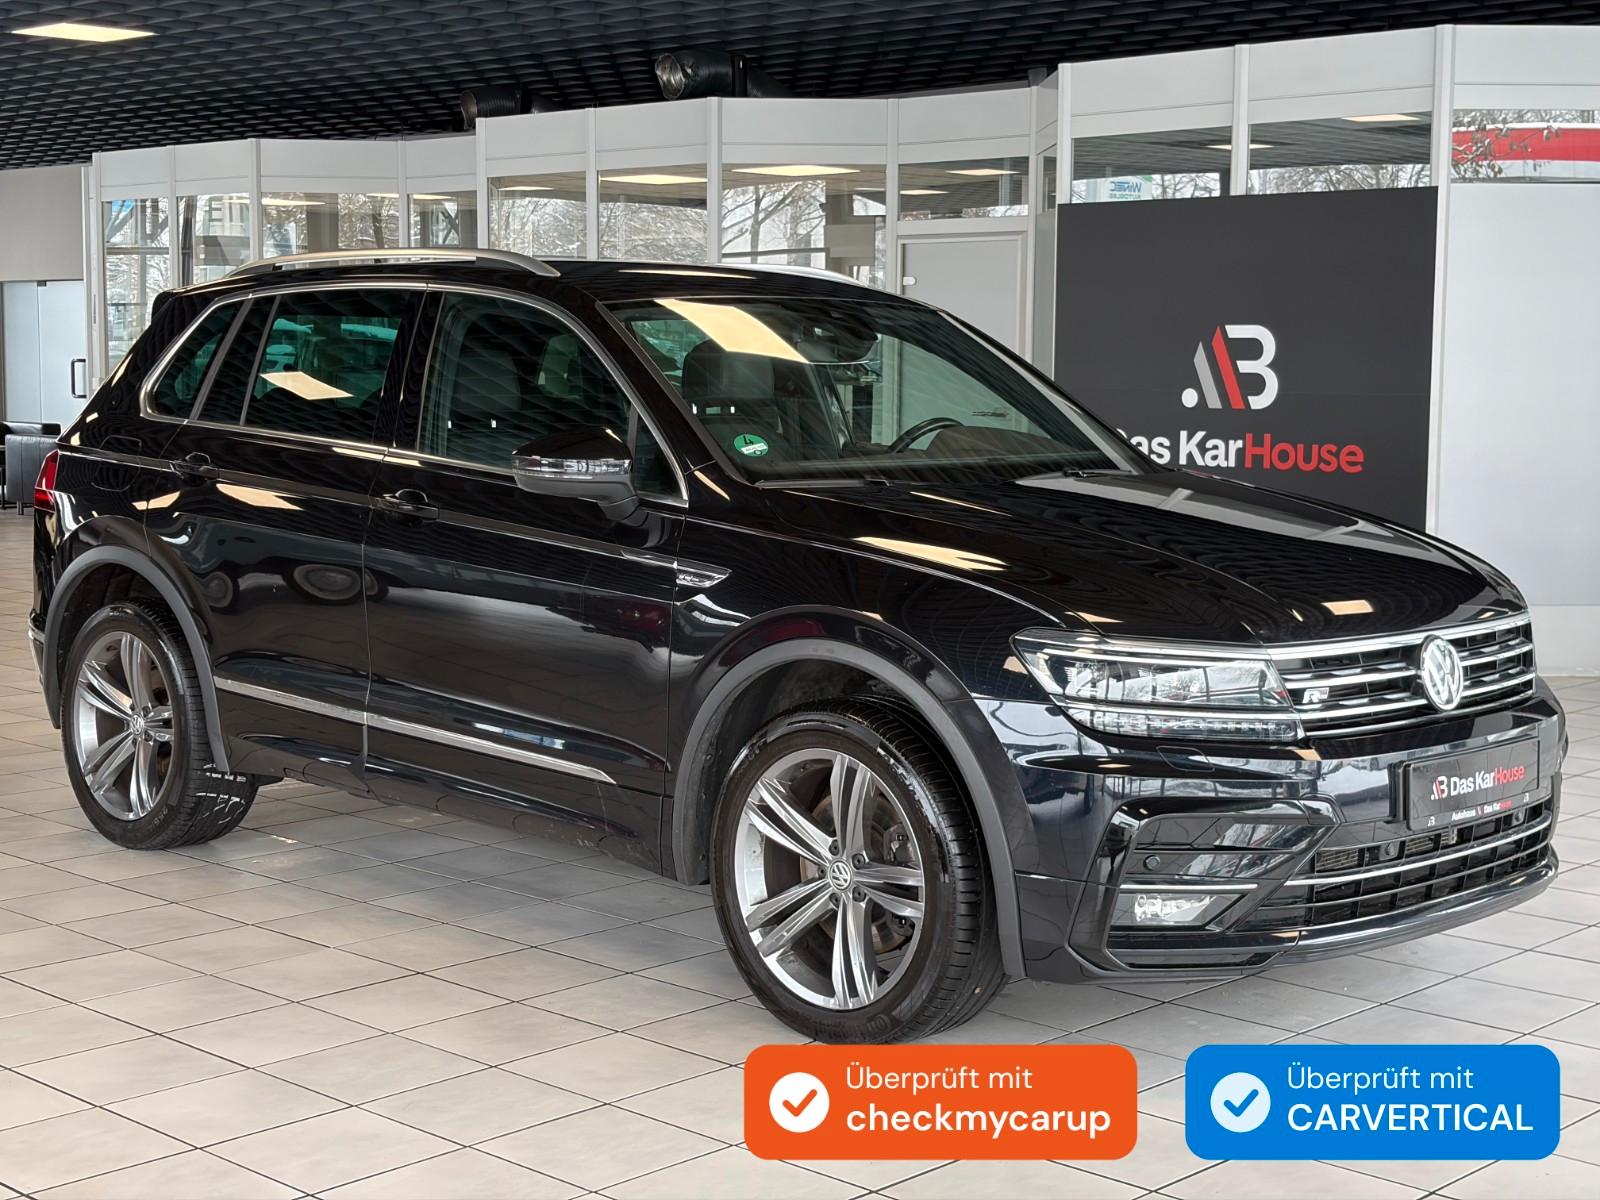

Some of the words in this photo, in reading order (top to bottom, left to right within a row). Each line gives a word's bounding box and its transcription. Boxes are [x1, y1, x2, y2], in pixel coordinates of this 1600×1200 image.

[1179, 430, 1365, 473] KarHouse
[1450, 776, 1475, 797] Das
[1475, 765, 1525, 791] KarHouse
